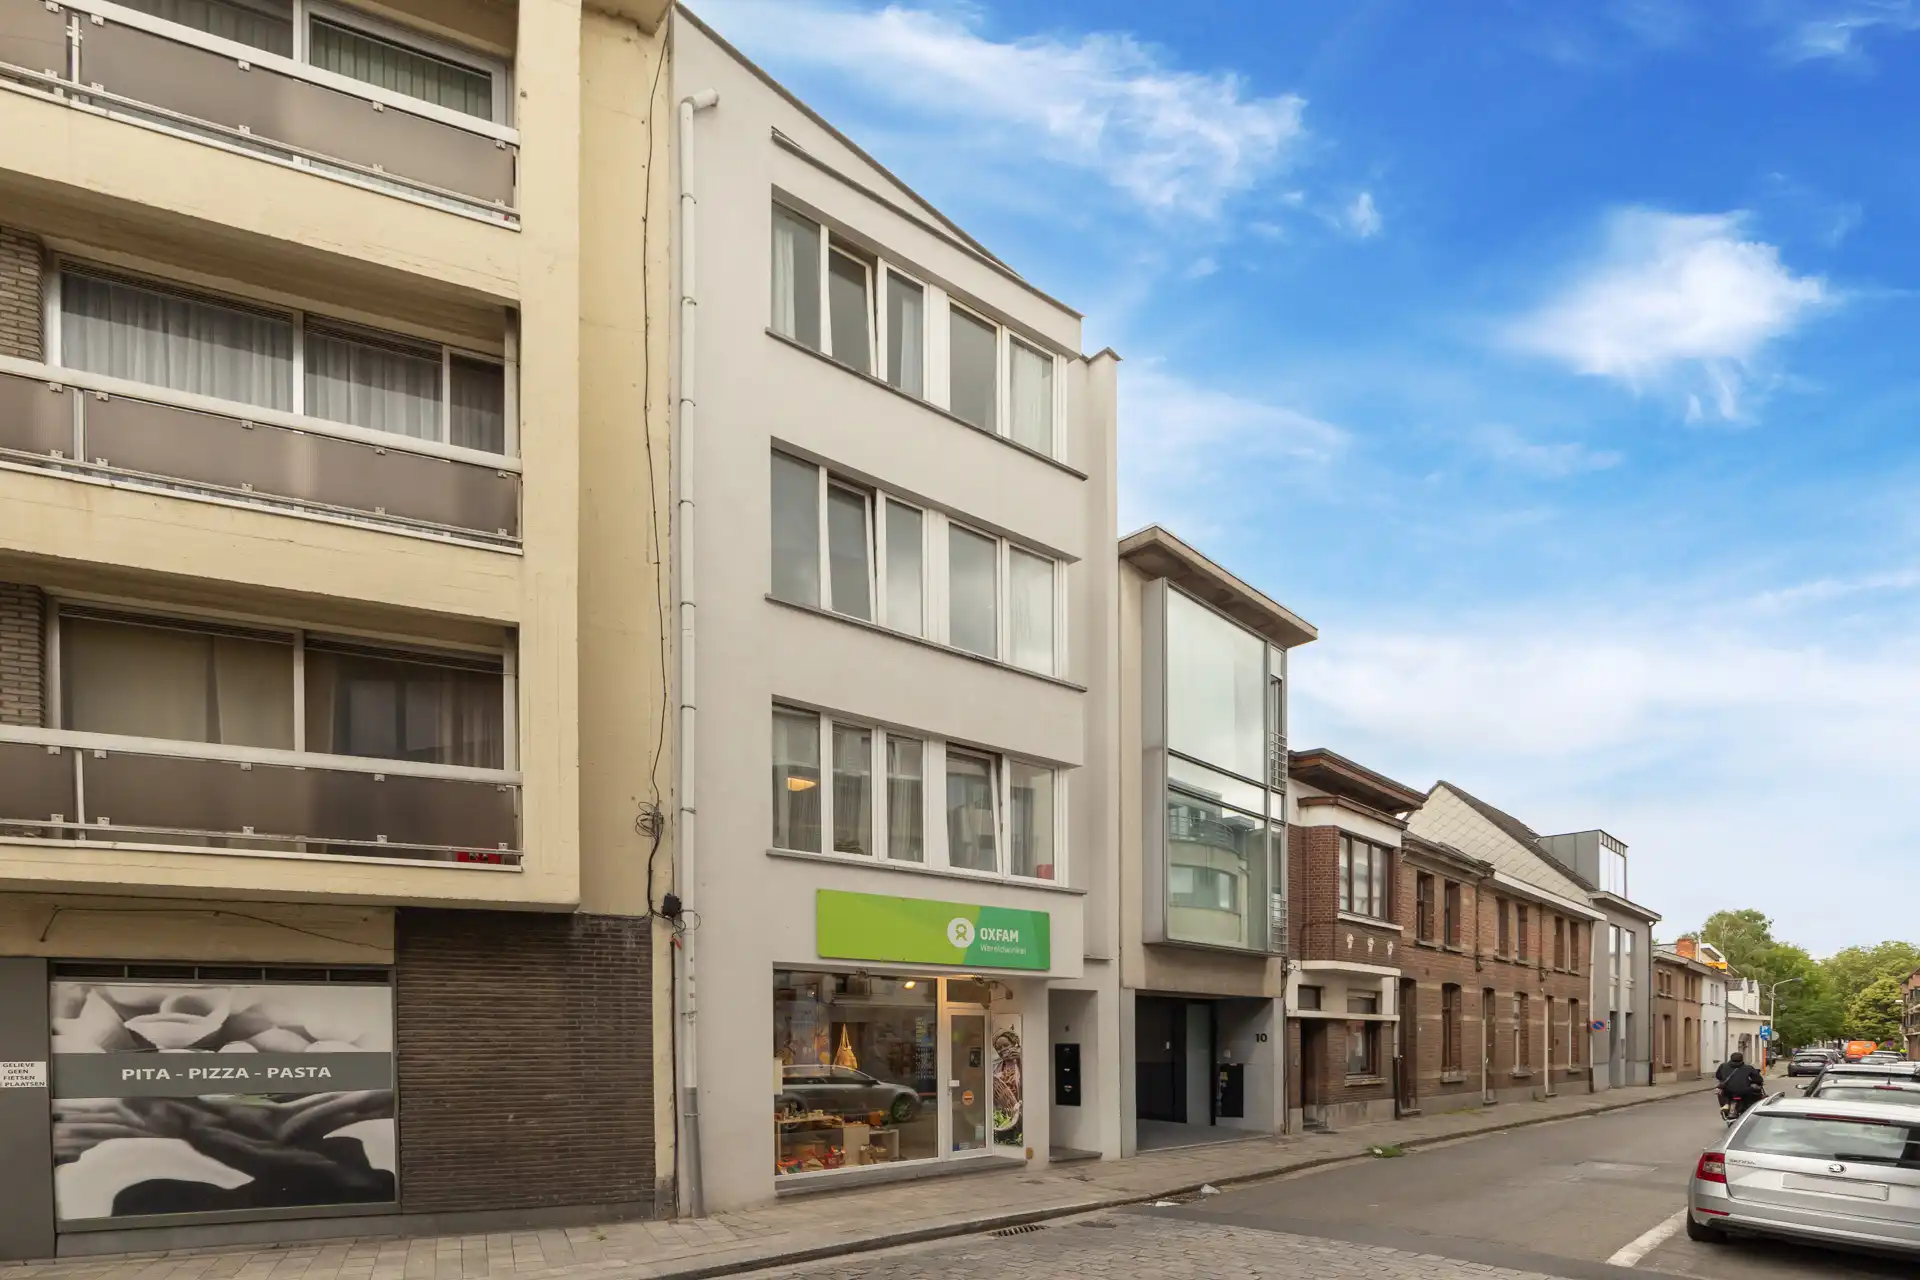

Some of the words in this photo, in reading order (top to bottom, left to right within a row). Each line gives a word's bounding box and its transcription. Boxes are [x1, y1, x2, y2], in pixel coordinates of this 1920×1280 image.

[980, 927, 1019, 942] OXFAM
[980, 944, 1027, 956] Wereldwinkel
[1255, 1033, 1268, 1043] 10
[121, 1068, 171, 1081] PITA
[188, 1067, 250, 1080] PIZZA
[267, 1066, 332, 1079] PASTA
